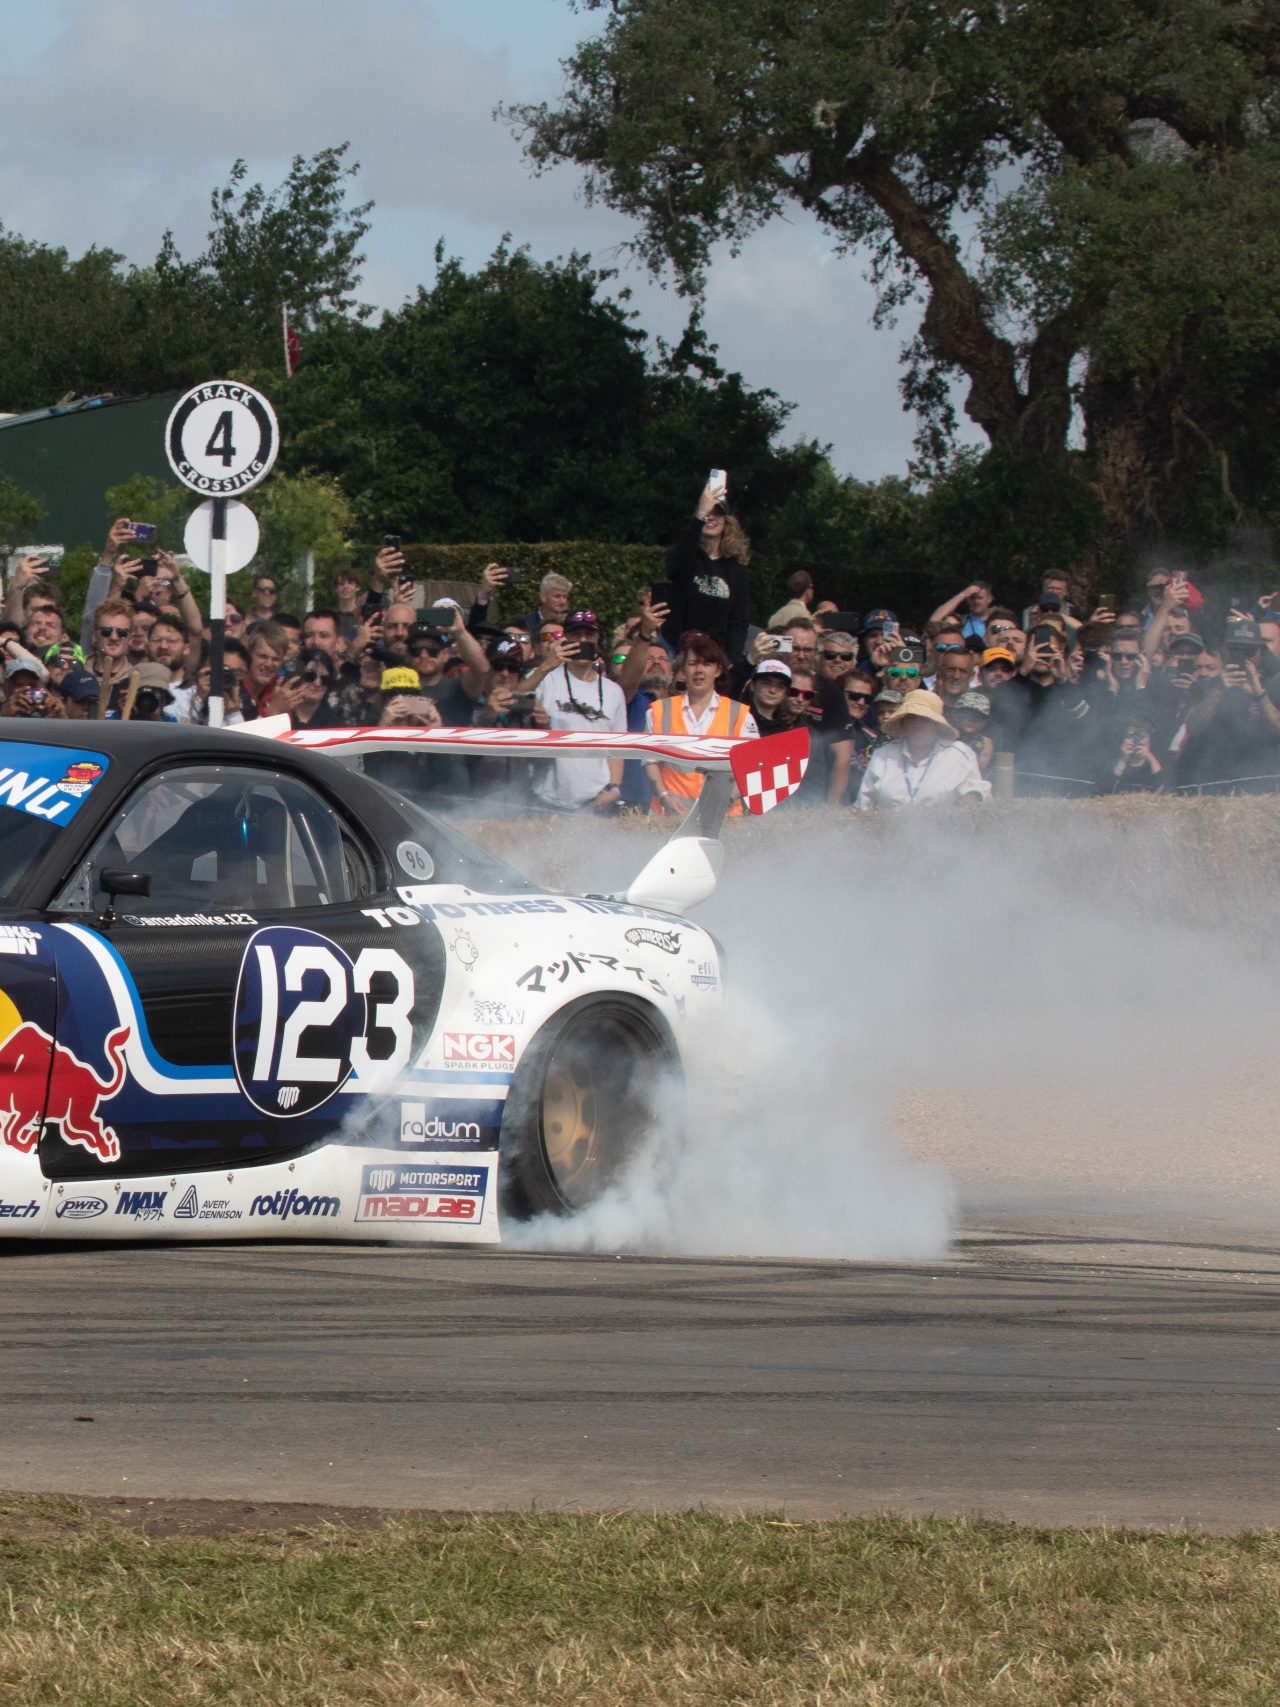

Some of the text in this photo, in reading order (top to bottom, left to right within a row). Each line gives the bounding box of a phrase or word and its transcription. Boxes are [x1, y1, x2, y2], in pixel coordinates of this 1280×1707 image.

[190, 385, 253, 406] TRACK
[205, 411, 236, 467] 4
[179, 460, 263, 491] CROSSING
[361, 901, 468, 928] TOYO
[465, 898, 568, 917] TIRES
[252, 945, 415, 1082] 123
[444, 1034, 514, 1061] NGK
[444, 1062, 514, 1071] SPARK PLUGS
[402, 1116, 481, 1138] radium
[400, 1172, 481, 1187] MOTORSPORT
[114, 1191, 168, 1215] MAX
[199, 1210, 243, 1219] DENNISON
[201, 1200, 230, 1209] AVERY
[249, 1188, 341, 1220] rotiform
